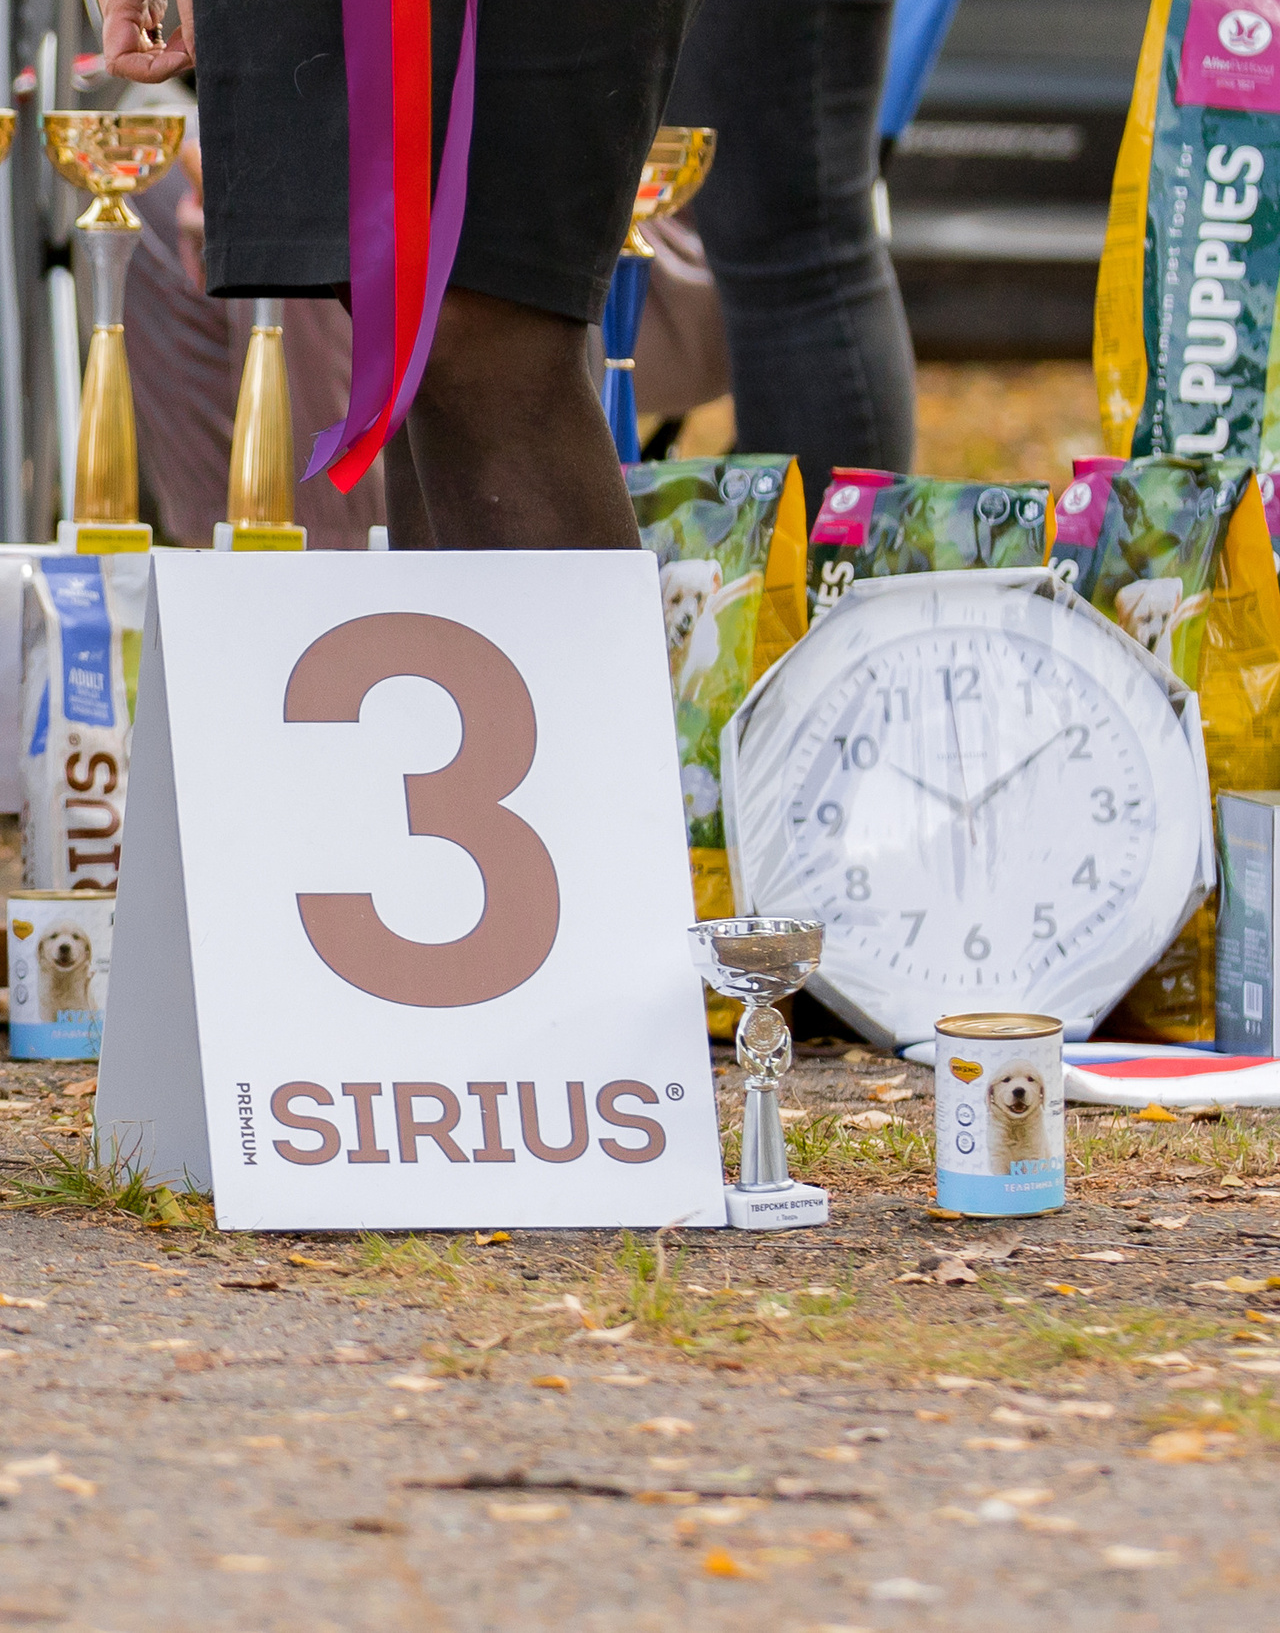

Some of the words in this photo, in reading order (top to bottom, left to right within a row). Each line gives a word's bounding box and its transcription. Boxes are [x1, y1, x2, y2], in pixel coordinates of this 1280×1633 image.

[1176, 142, 1193, 178] for
[1169, 186, 1188, 238] food
[1166, 246, 1180, 284] pet
[1179, 144, 1265, 404] PUPPIES
[1158, 293, 1175, 390] premium
[936, 666, 982, 702] 12
[1019, 680, 1034, 715] 1
[876, 685, 911, 723] 11
[834, 734, 879, 770] 10
[1065, 725, 1093, 759] 2
[283, 612, 560, 1008] 3
[817, 802, 845, 837] 9
[1090, 786, 1118, 824] 3
[845, 865, 872, 901] 8
[1072, 854, 1100, 891] 4
[900, 909, 928, 948] 7
[1032, 902, 1057, 940] 5
[963, 923, 991, 961] 6
[236, 1082, 258, 1165] PREMIUM
[751, 1202, 788, 1212] ТВЕРСКИЕ
[790, 1198, 824, 1209] ВСТРЕЧИ
